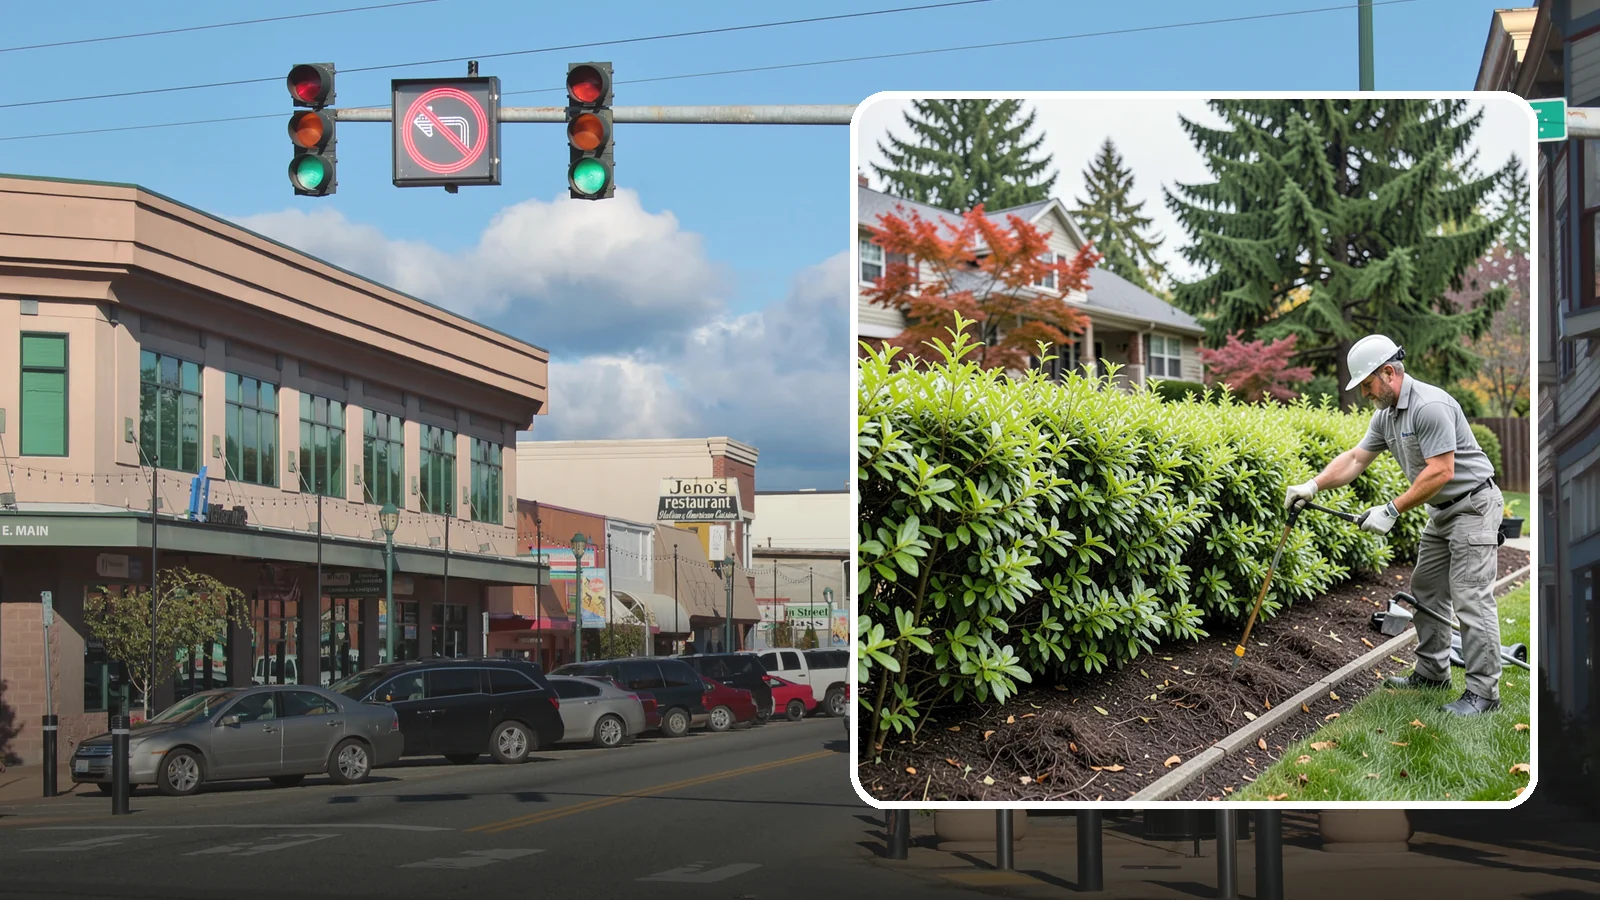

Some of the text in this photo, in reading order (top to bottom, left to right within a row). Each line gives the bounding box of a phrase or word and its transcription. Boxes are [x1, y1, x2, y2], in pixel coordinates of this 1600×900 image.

[669, 480, 728, 495] Jeno's
[665, 496, 731, 509] restaurant
[658, 509, 682, 520] Italian
[686, 509, 715, 520] American
[715, 509, 738, 520] Cuisine
[2, 525, 49, 536] E. MAIN
[797, 607, 828, 617] Street
[791, 619, 823, 627] lass
